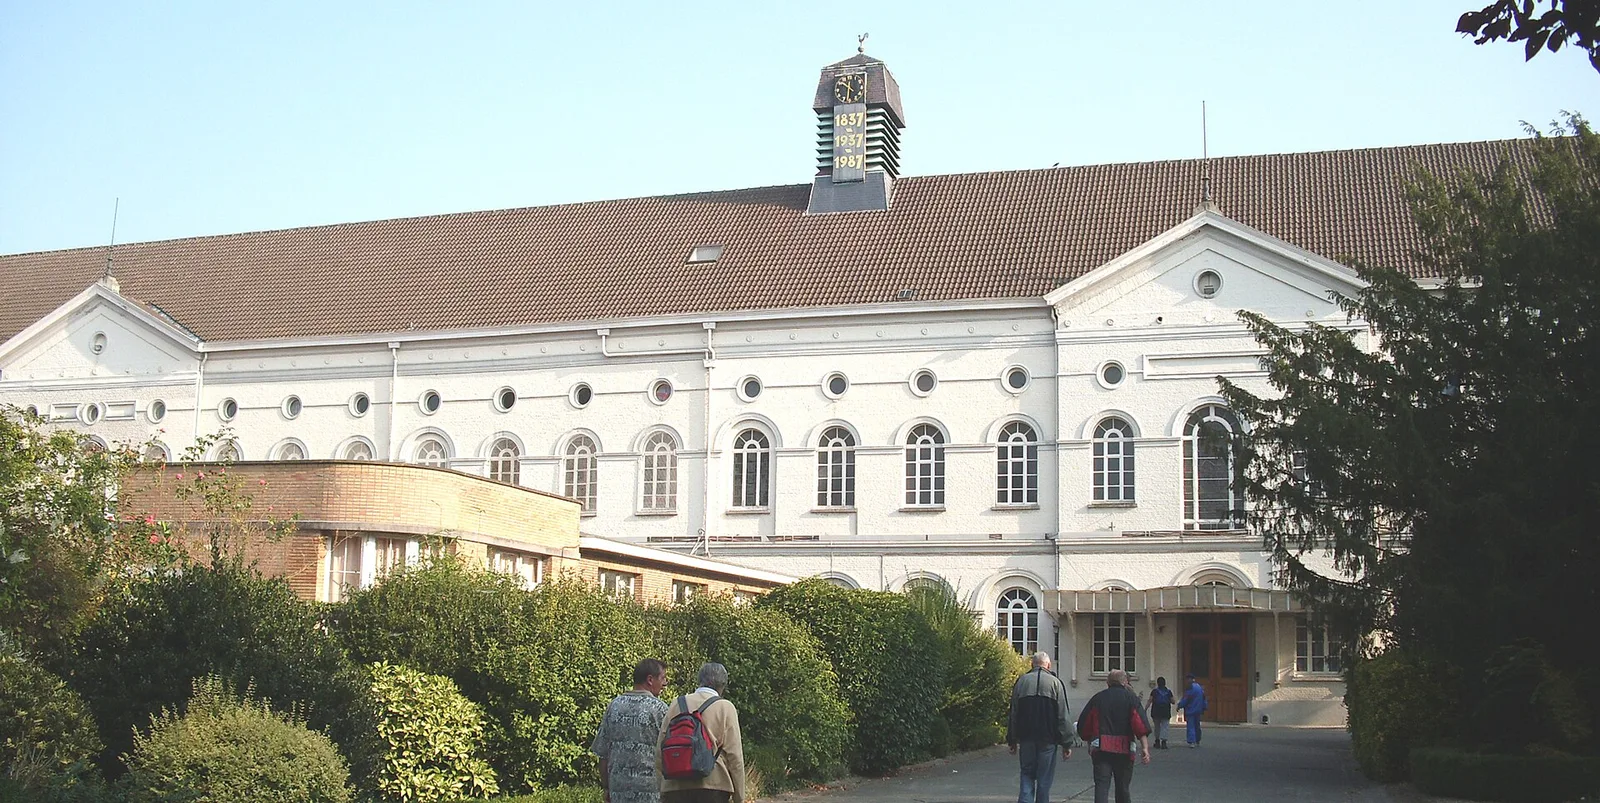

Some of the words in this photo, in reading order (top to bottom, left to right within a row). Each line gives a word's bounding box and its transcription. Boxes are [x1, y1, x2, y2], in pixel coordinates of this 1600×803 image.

[835, 112, 864, 127] 1837
[834, 133, 864, 148] 1937
[834, 154, 863, 169] 1987
